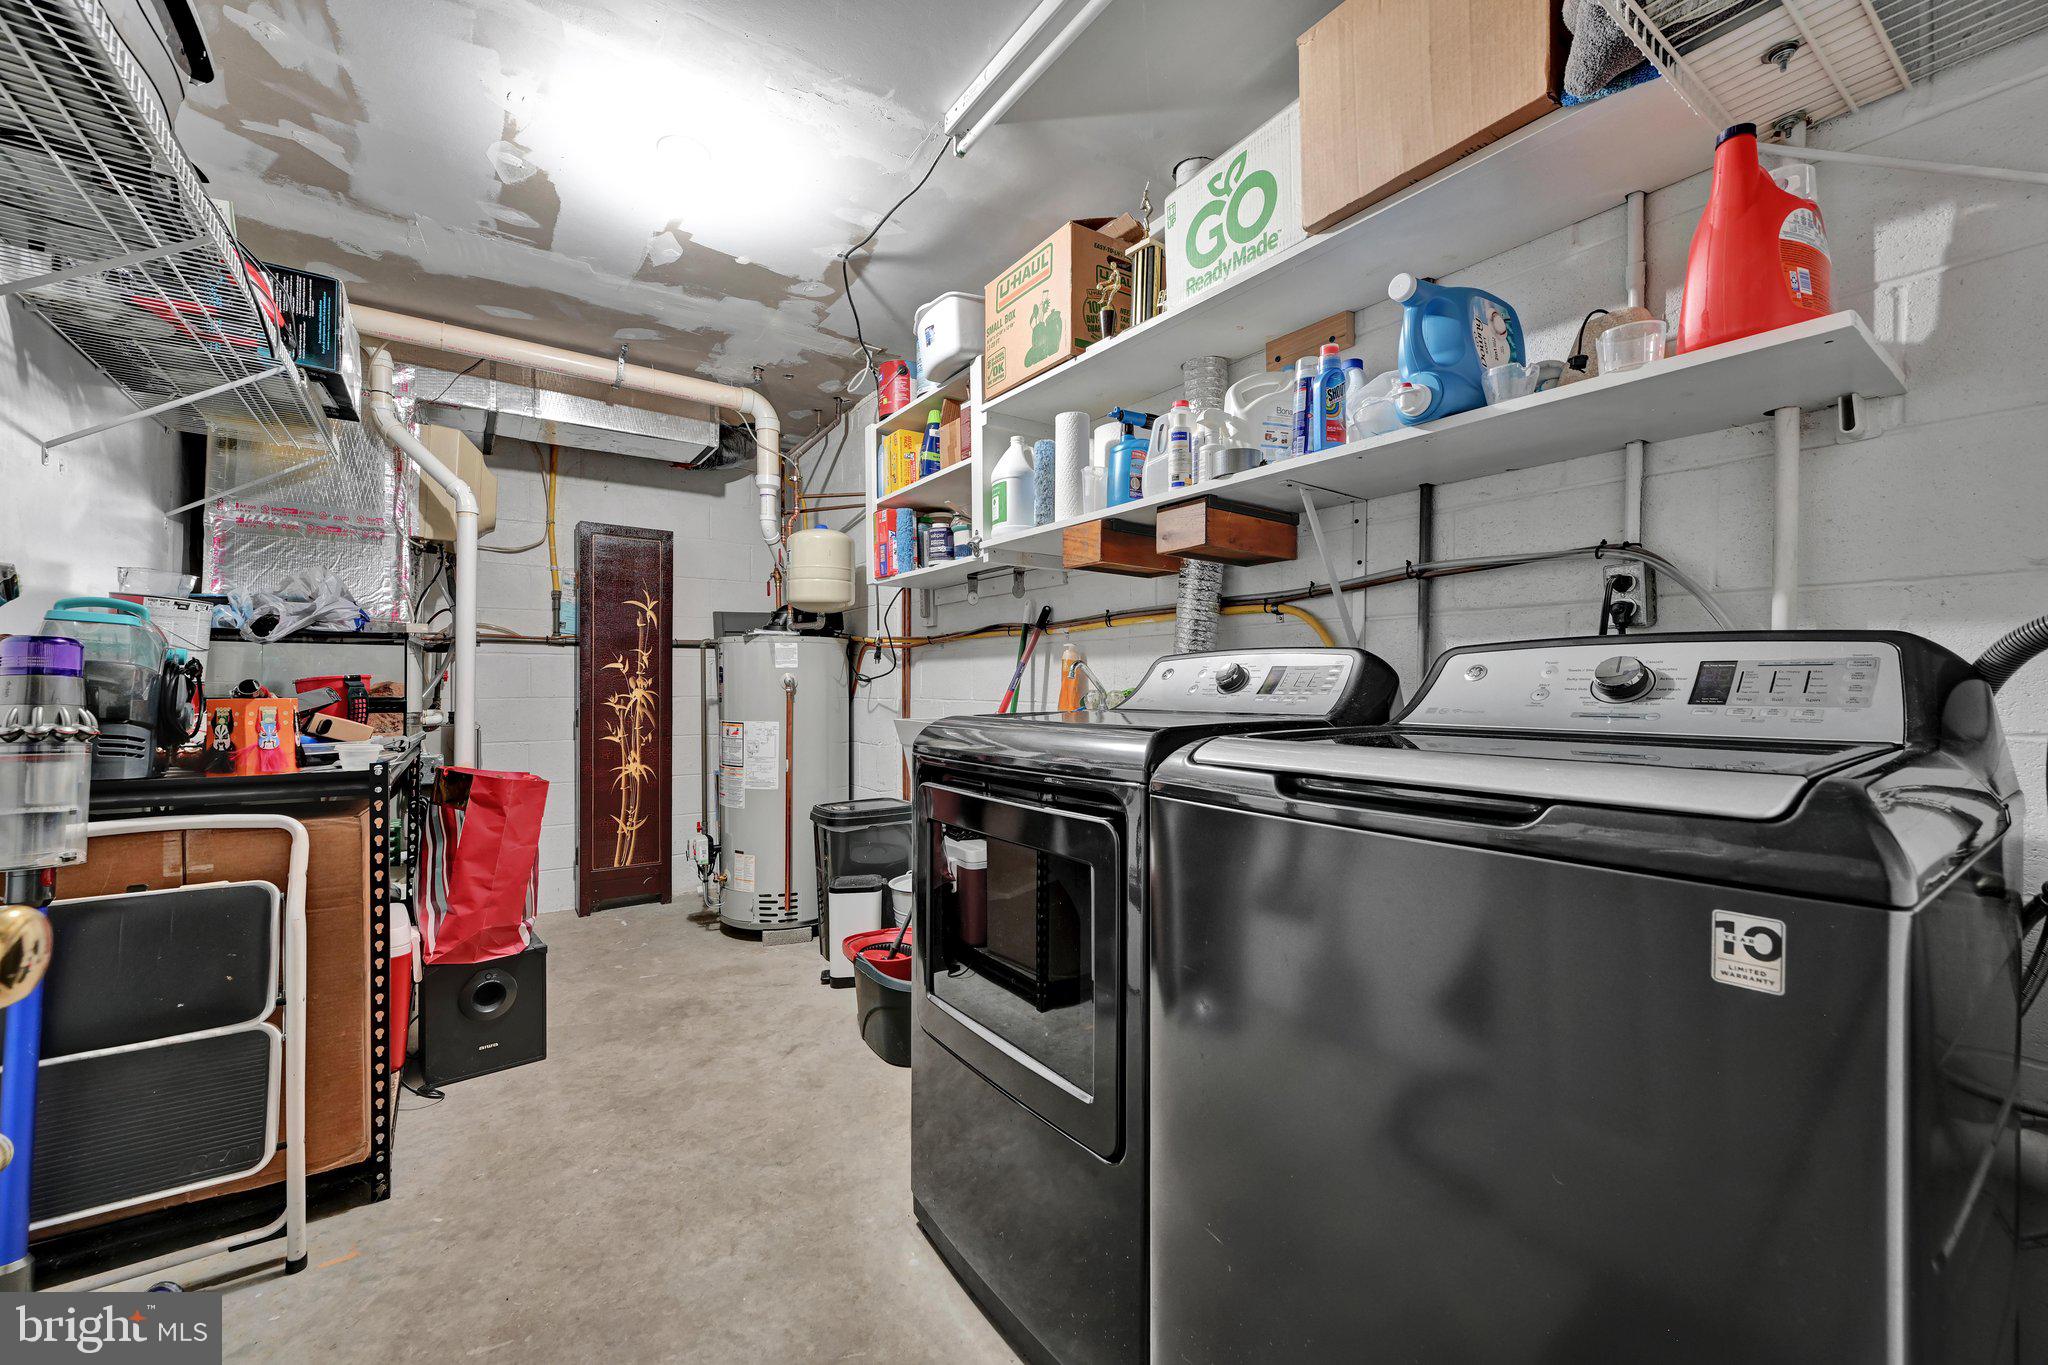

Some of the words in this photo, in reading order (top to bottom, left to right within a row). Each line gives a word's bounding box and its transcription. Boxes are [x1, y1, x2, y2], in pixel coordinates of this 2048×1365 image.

[1186, 170, 1278, 269] GO
[1000, 252, 1049, 299] U-HAUL
[1276, 406, 1294, 416] Bona
[1715, 920, 1782, 962] 10
[1723, 934, 1755, 944] YEAR
[1720, 969, 1775, 986] WARRANTY
[1728, 964, 1768, 977] LIMITED
